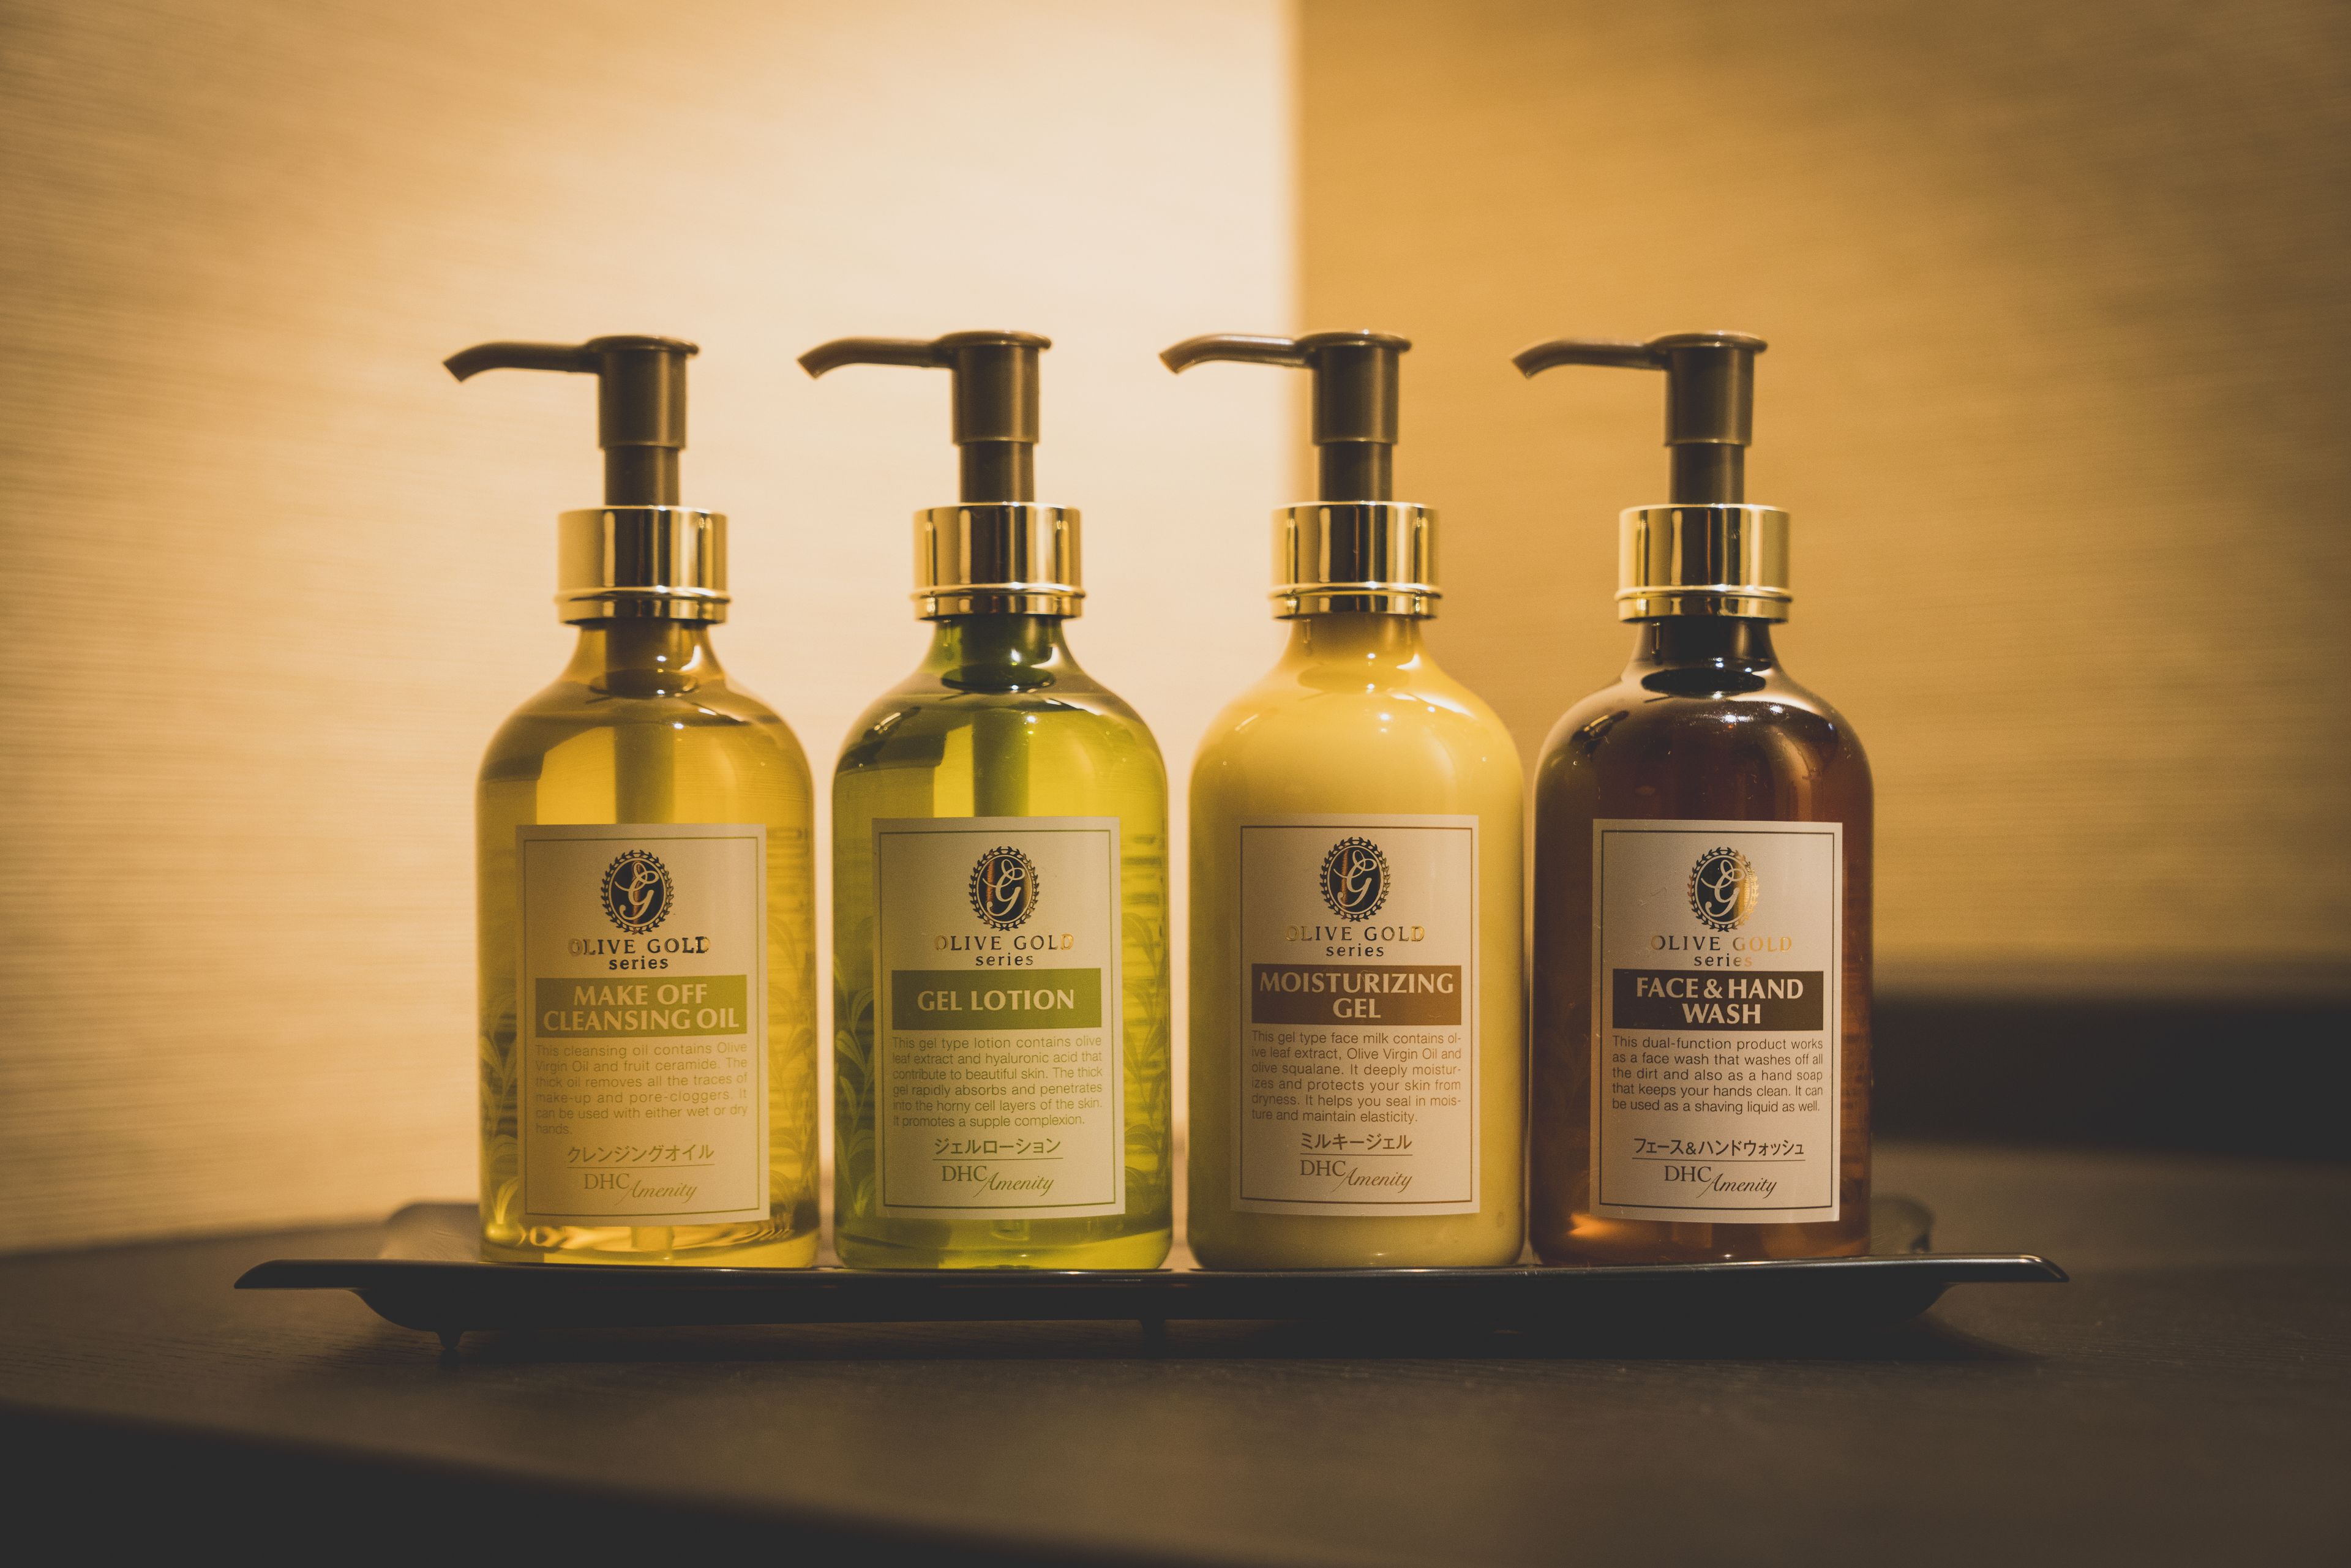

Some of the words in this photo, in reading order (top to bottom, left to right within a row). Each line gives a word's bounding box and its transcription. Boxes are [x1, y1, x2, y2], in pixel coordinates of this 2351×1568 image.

[1286, 925, 1352, 941] OLIVE
[1364, 926, 1425, 942] GOLD
[569, 939, 636, 956] OLIVE
[647, 936, 710, 953] GOLD
[936, 935, 1002, 951] OLIVE
[1013, 934, 1074, 950] GOLD
[1326, 942, 1384, 957] series
[1651, 936, 1720, 951] OLIVE
[1733, 937, 1793, 952] GOLD
[609, 955, 669, 970] series
[975, 951, 1033, 966] series
[1694, 951, 1752, 967] series
[1259, 972, 1454, 994] MOISTURIZING
[1636, 977, 1698, 999] FACE
[1703, 978, 1723, 999] &
[1728, 978, 1804, 999] HAND
[574, 985, 648, 1005] MAKE
[657, 983, 707, 1004] OFF
[918, 990, 962, 1011] GEL
[971, 989, 1074, 1010] LOTION
[1333, 998, 1381, 1019] GEL
[1682, 1003, 1761, 1024] WASH
[543, 1008, 691, 1031] CLEANSING
[697, 1008, 739, 1029] OIL
[919, 1038, 937, 1051] gel
[942, 1038, 969, 1051] type
[974, 1037, 1011, 1048] lotion
[1016, 1036, 1071, 1048] contains
[1252, 1030, 1273, 1042] This
[1278, 1032, 1295, 1045] gel
[1300, 1032, 1327, 1045] type
[1332, 1032, 1359, 1044] face
[1363, 1033, 1389, 1044] milk
[1393, 1033, 1444, 1044] contains
[1448, 1033, 1461, 1043] ol-
[1613, 1035, 1637, 1048] This
[1643, 1037, 1731, 1049] dual-function
[1737, 1039, 1786, 1051] product
[1791, 1038, 1823, 1049] works
[564, 1045, 627, 1059] cleansing
[654, 1044, 712, 1055] contains
[914, 1054, 953, 1064] extract
[958, 1053, 981, 1064] and
[986, 1052, 1049, 1067] hyaluronic
[1053, 1051, 1078, 1063] acid
[1082, 1051, 1102, 1062] that
[1270, 1048, 1291, 1058] leaf
[1294, 1048, 1341, 1060] extract,
[1347, 1048, 1379, 1060] Olive
[1383, 1048, 1418, 1062] Virgin
[1422, 1048, 1438, 1059] Oil
[1441, 1048, 1461, 1059] and
[1613, 1054, 1625, 1062] as
[1630, 1054, 1637, 1063] a
[1642, 1052, 1669, 1064] face
[1674, 1054, 1709, 1064] wash
[1714, 1054, 1739, 1065] that
[1744, 1054, 1791, 1065] washes
[1795, 1054, 1809, 1065] off
[1812, 1054, 1823, 1064] all
[593, 1060, 618, 1071] and
[624, 1060, 650, 1071] fruit
[893, 1068, 947, 1079] contribute
[950, 1070, 962, 1079] to
[966, 1068, 1017, 1079] beautiful
[1021, 1067, 1048, 1079] skin.
[1052, 1067, 1074, 1078] The
[1078, 1067, 1103, 1078] thick
[1251, 1062, 1277, 1073] olive
[1282, 1063, 1344, 1076] squalane.
[1350, 1065, 1358, 1075] It
[1364, 1064, 1408, 1078] deeply
[1412, 1064, 1461, 1075] moistur-
[567, 1076, 580, 1087] oil
[585, 1077, 642, 1087] removes
[647, 1076, 662, 1087] all
[667, 1076, 688, 1086] the
[694, 1074, 732, 1086] traces
[1613, 1067, 1632, 1078] the
[1637, 1068, 1658, 1079] dirt
[1663, 1069, 1689, 1080] and
[1695, 1070, 1722, 1081] also
[1728, 1072, 1743, 1081] as
[1749, 1072, 1756, 1081] a
[1761, 1070, 1791, 1081] hand
[1797, 1071, 1823, 1082] soap
[912, 1084, 950, 1098] rapidly
[954, 1084, 1007, 1095] absorbs
[1011, 1084, 1035, 1095] and
[1040, 1082, 1103, 1097] penetrates
[1278, 1079, 1302, 1089] and
[1308, 1080, 1364, 1092] protects
[1370, 1082, 1399, 1093] your
[1404, 1080, 1430, 1091] skin
[1435, 1080, 1461, 1090] from
[1613, 1083, 1634, 1094] that
[1638, 1084, 1676, 1097] keeps
[1681, 1087, 1709, 1098] your
[1714, 1085, 1752, 1097] hands
[1757, 1086, 1791, 1097] clean.
[1796, 1086, 1801, 1096] It
[1805, 1087, 1823, 1096] can
[597, 1092, 623, 1103] and
[1305, 1095, 1313, 1105] It
[1318, 1095, 1352, 1108] helps
[1357, 1098, 1381, 1109] you
[1386, 1096, 1411, 1106] seal
[1415, 1096, 1425, 1106] in
[1430, 1095, 1461, 1106] mois-
[578, 1108, 609, 1119] used
[613, 1107, 640, 1119] with
[645, 1107, 682, 1118] either
[686, 1106, 709, 1117] wet
[916, 1100, 932, 1111] the
[937, 1100, 970, 1114] horny
[975, 1100, 996, 1111] cell
[1000, 1100, 1036, 1113] layers
[1040, 1099, 1052, 1109] of
[1057, 1098, 1074, 1109] the
[1078, 1098, 1102, 1109] skin.
[1613, 1099, 1627, 1109] be
[1630, 1100, 1659, 1111] used
[1664, 1103, 1678, 1111] as
[1683, 1103, 1690, 1111] a
[1695, 1101, 1742, 1114] shaving
[1747, 1101, 1778, 1114] liquid
[1782, 1103, 1794, 1112] as
[1798, 1101, 1820, 1112] well.
[902, 1116, 955, 1128] promotes
[959, 1118, 966, 1127] a
[970, 1116, 1010, 1129] supple
[1014, 1115, 1085, 1128] complexion.
[1252, 1109, 1273, 1120] ture
[1277, 1109, 1298, 1120] and
[1303, 1111, 1355, 1122] maintain
[1360, 1111, 1417, 1125] elasticity.
[935, 1138, 1061, 1154] ジェルローション
[1302, 1133, 1412, 1150] ミルキージェル
[1634, 1138, 1804, 1157] フェース&ハンドウォッシュ
[568, 1144, 714, 1163] クレンジングオイル
[942, 1166, 988, 1182] DHC
[973, 1172, 1054, 1198] Amenity
[1300, 1160, 1346, 1176] DHC
[1330, 1167, 1413, 1193] Amenity
[1664, 1166, 1712, 1182] DHC
[1697, 1173, 1777, 1199] Amenity
[584, 1174, 630, 1190] DHC
[615, 1180, 698, 1206] Amenity
